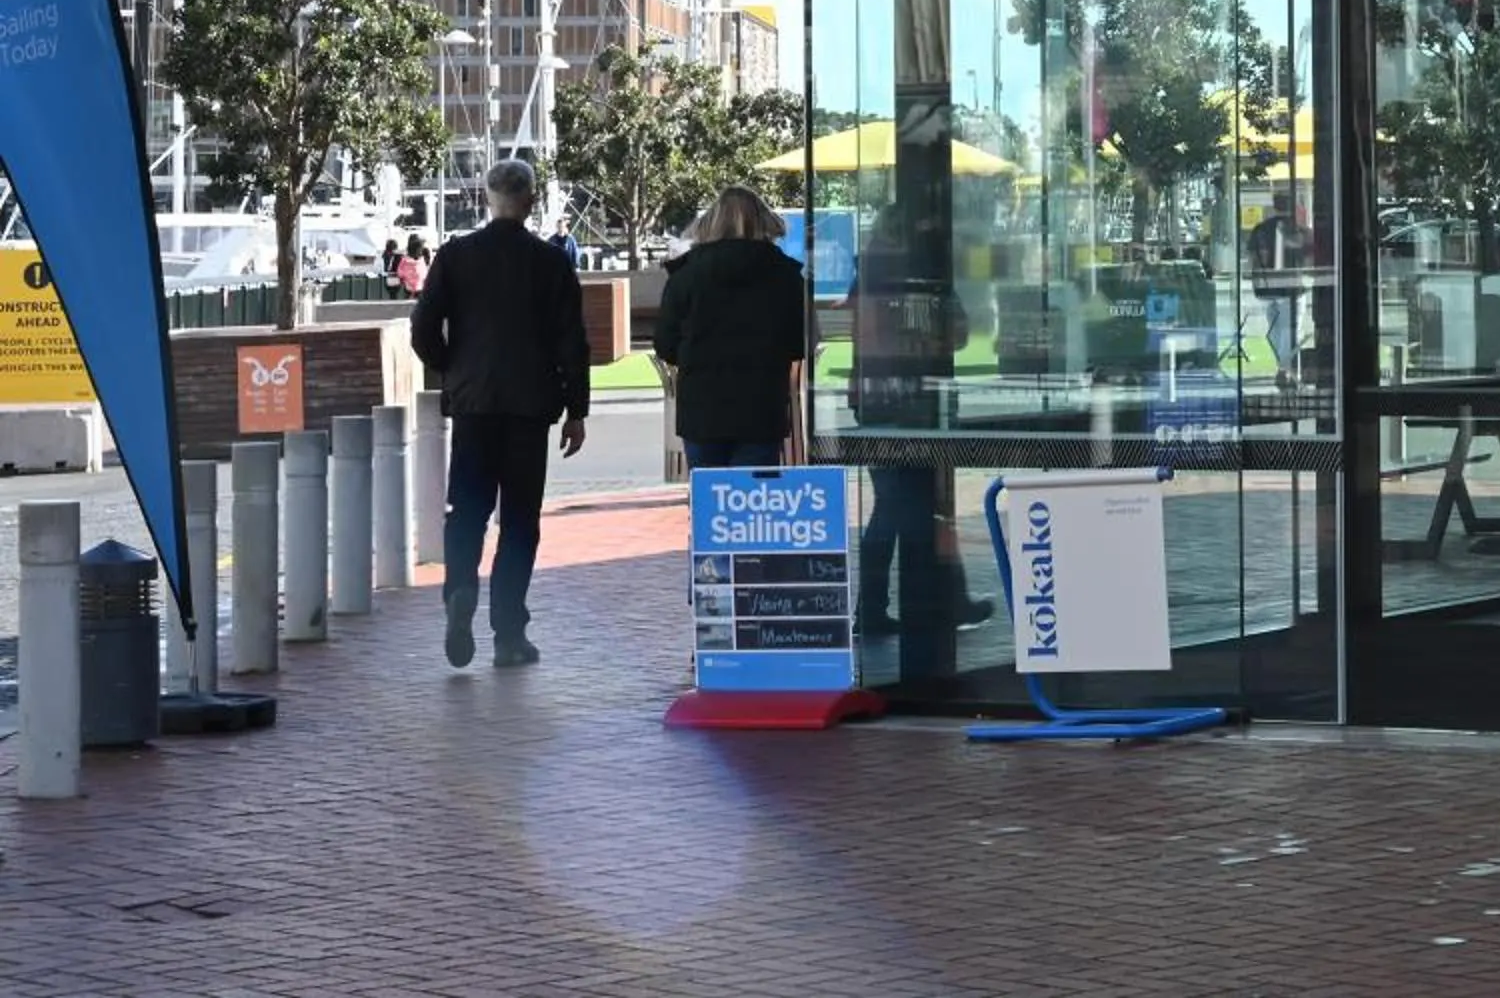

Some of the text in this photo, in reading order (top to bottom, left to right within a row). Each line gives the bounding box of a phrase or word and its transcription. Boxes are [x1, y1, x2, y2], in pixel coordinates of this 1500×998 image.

[0, 34, 59, 67] Today
[16, 317, 61, 327] AHEAD
[711, 482, 827, 517] Today's
[711, 514, 828, 548] Sailings
[1022, 501, 1059, 659] kōkako
